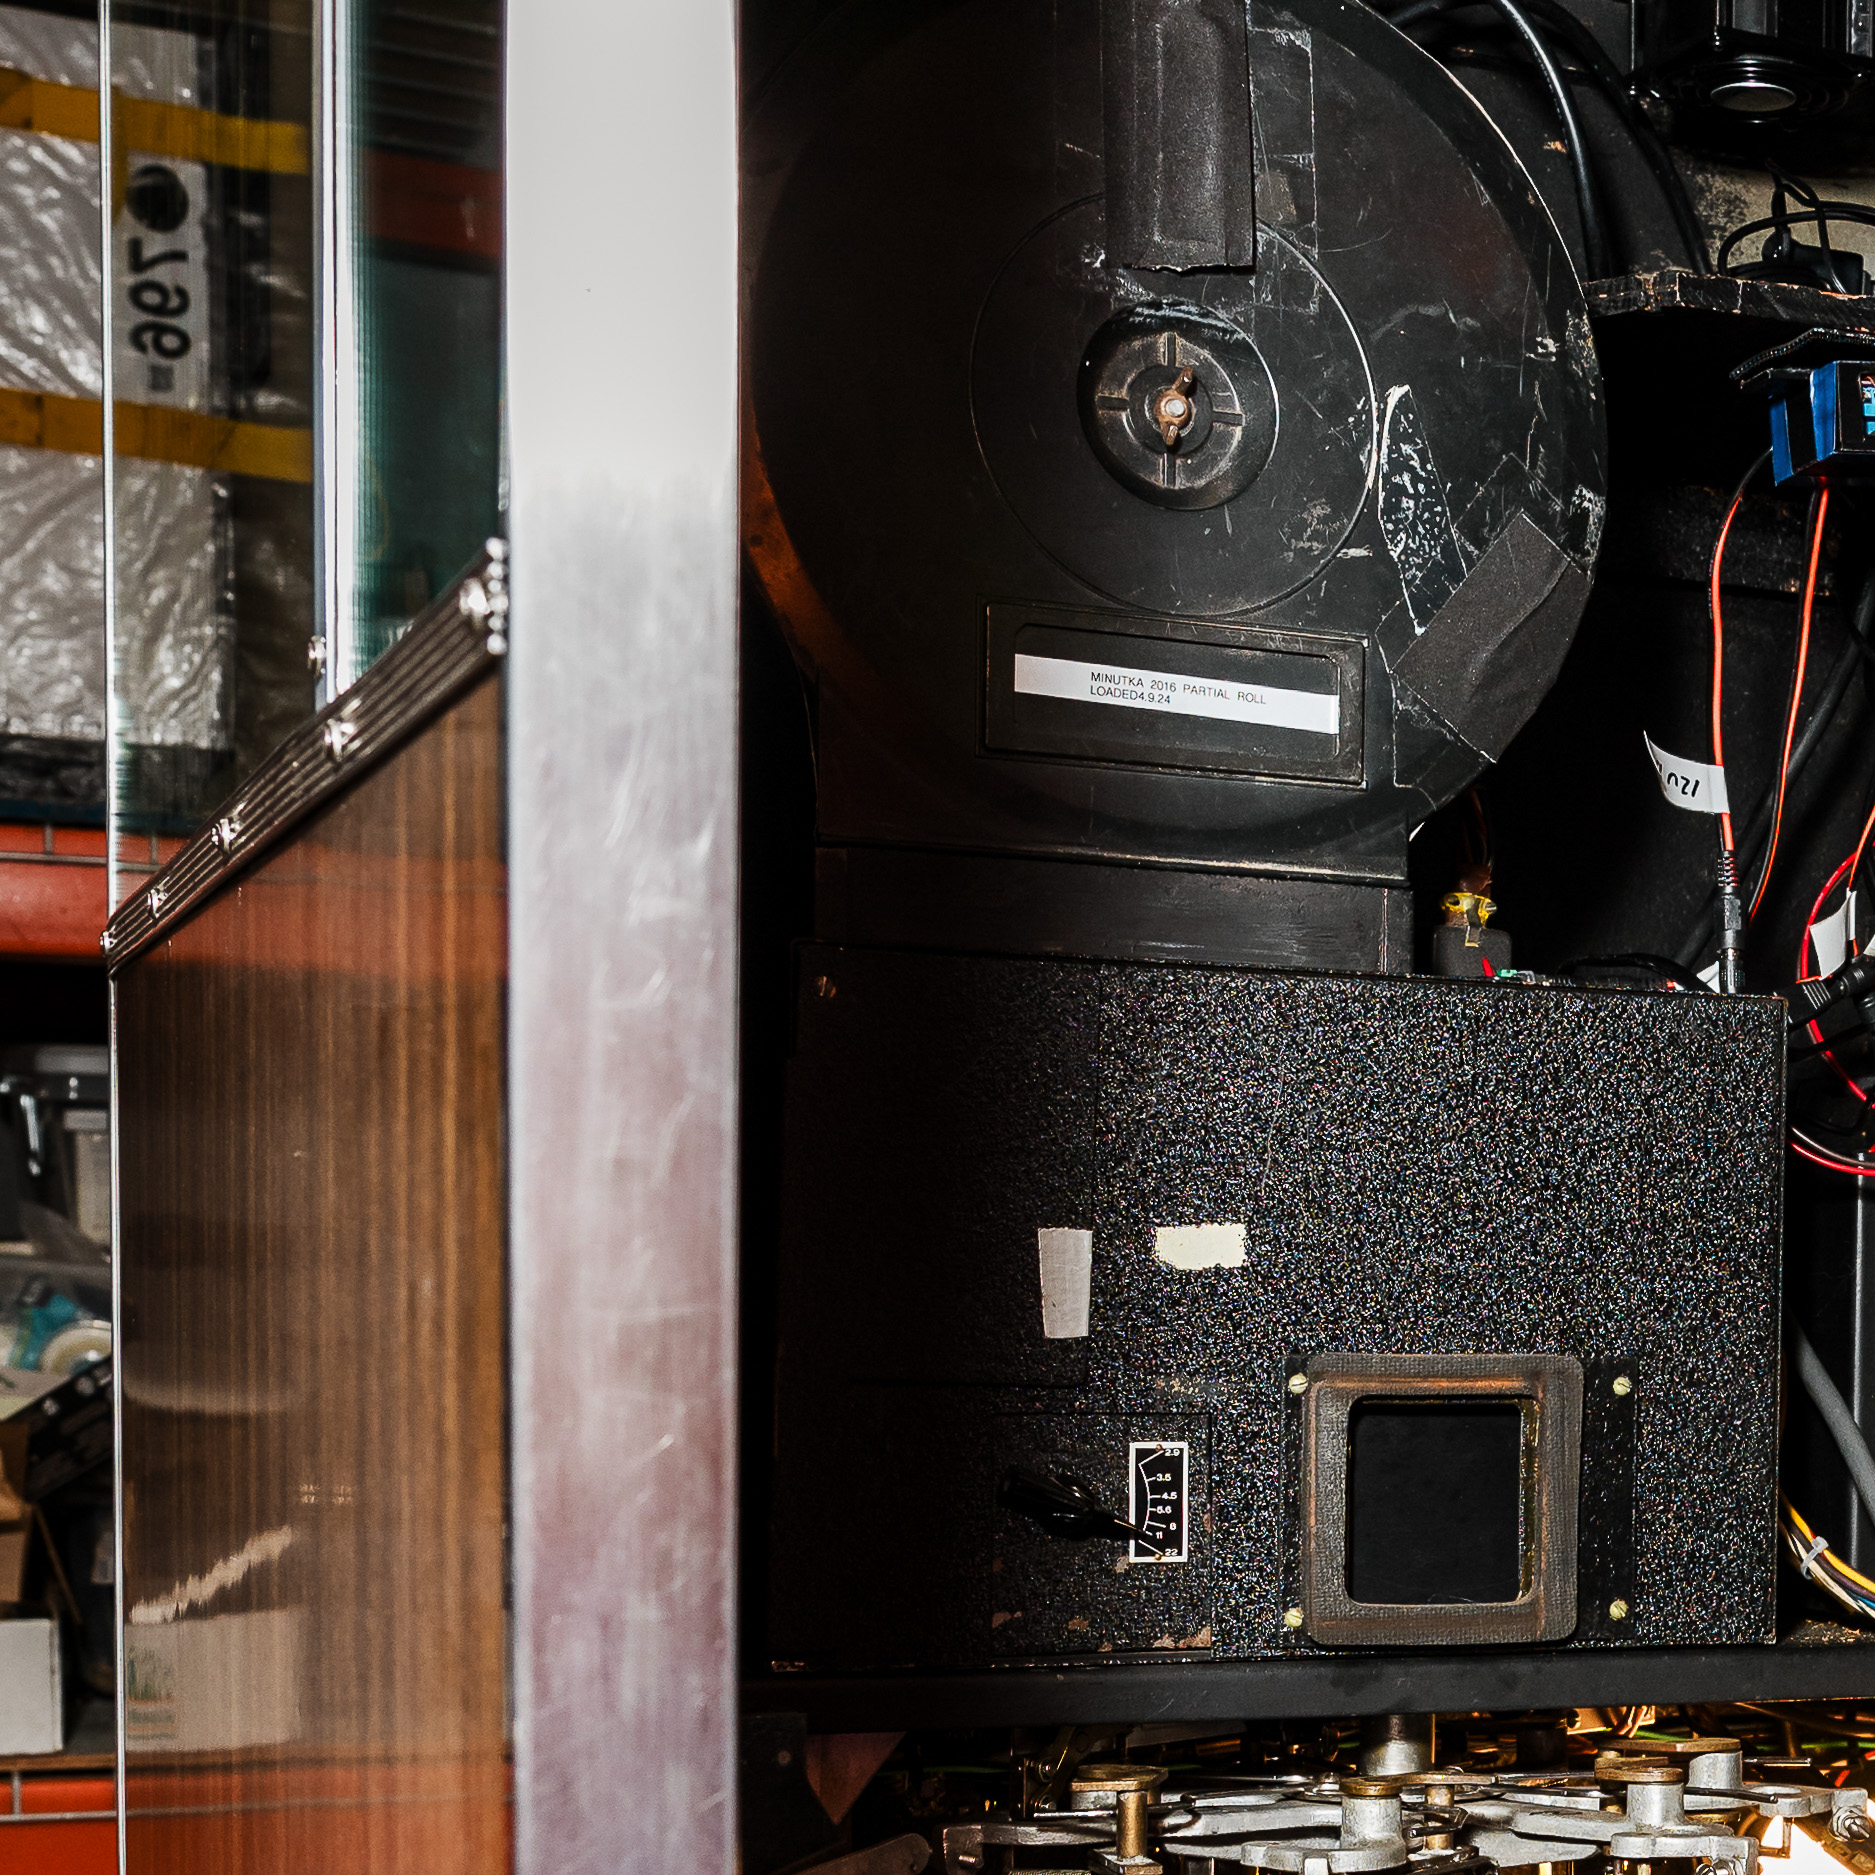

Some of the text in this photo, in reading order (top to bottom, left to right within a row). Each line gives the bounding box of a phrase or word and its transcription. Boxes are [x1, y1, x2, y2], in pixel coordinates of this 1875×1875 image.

[1090, 671, 1266, 705] MINUTKA 2016 PARTIAL ROLL
[1164, 1448, 1180, 1457] 2.9
[1156, 1473, 1171, 1481] 3.5
[1161, 1492, 1177, 1500] 4.5
[1155, 1531, 1163, 1539] 11
[1164, 1548, 1178, 1556] 22
